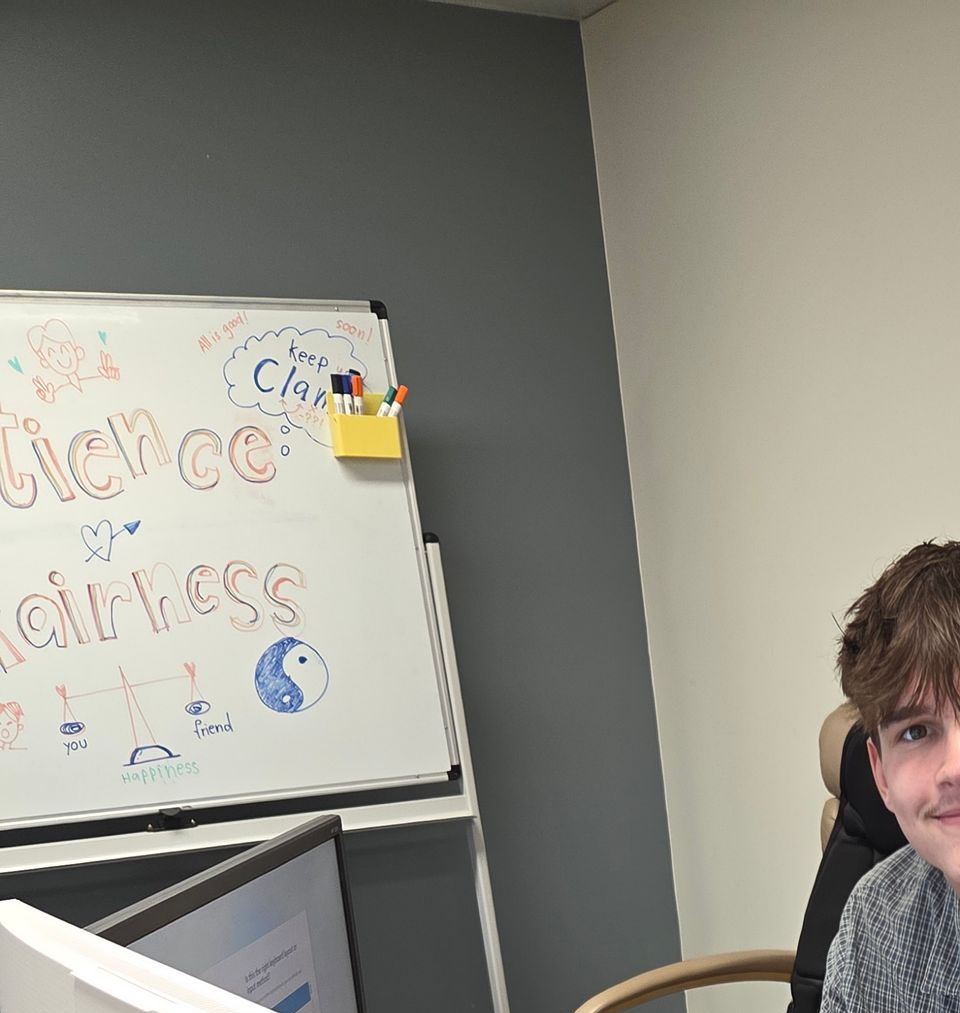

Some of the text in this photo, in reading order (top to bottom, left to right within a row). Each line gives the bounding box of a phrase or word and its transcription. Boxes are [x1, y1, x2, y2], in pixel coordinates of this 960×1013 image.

[198, 334, 213, 353] All
[223, 310, 249, 340] good!
[335, 319, 373, 343] soon!
[0, 559, 308, 674] airness
[193, 712, 234, 739] friend
